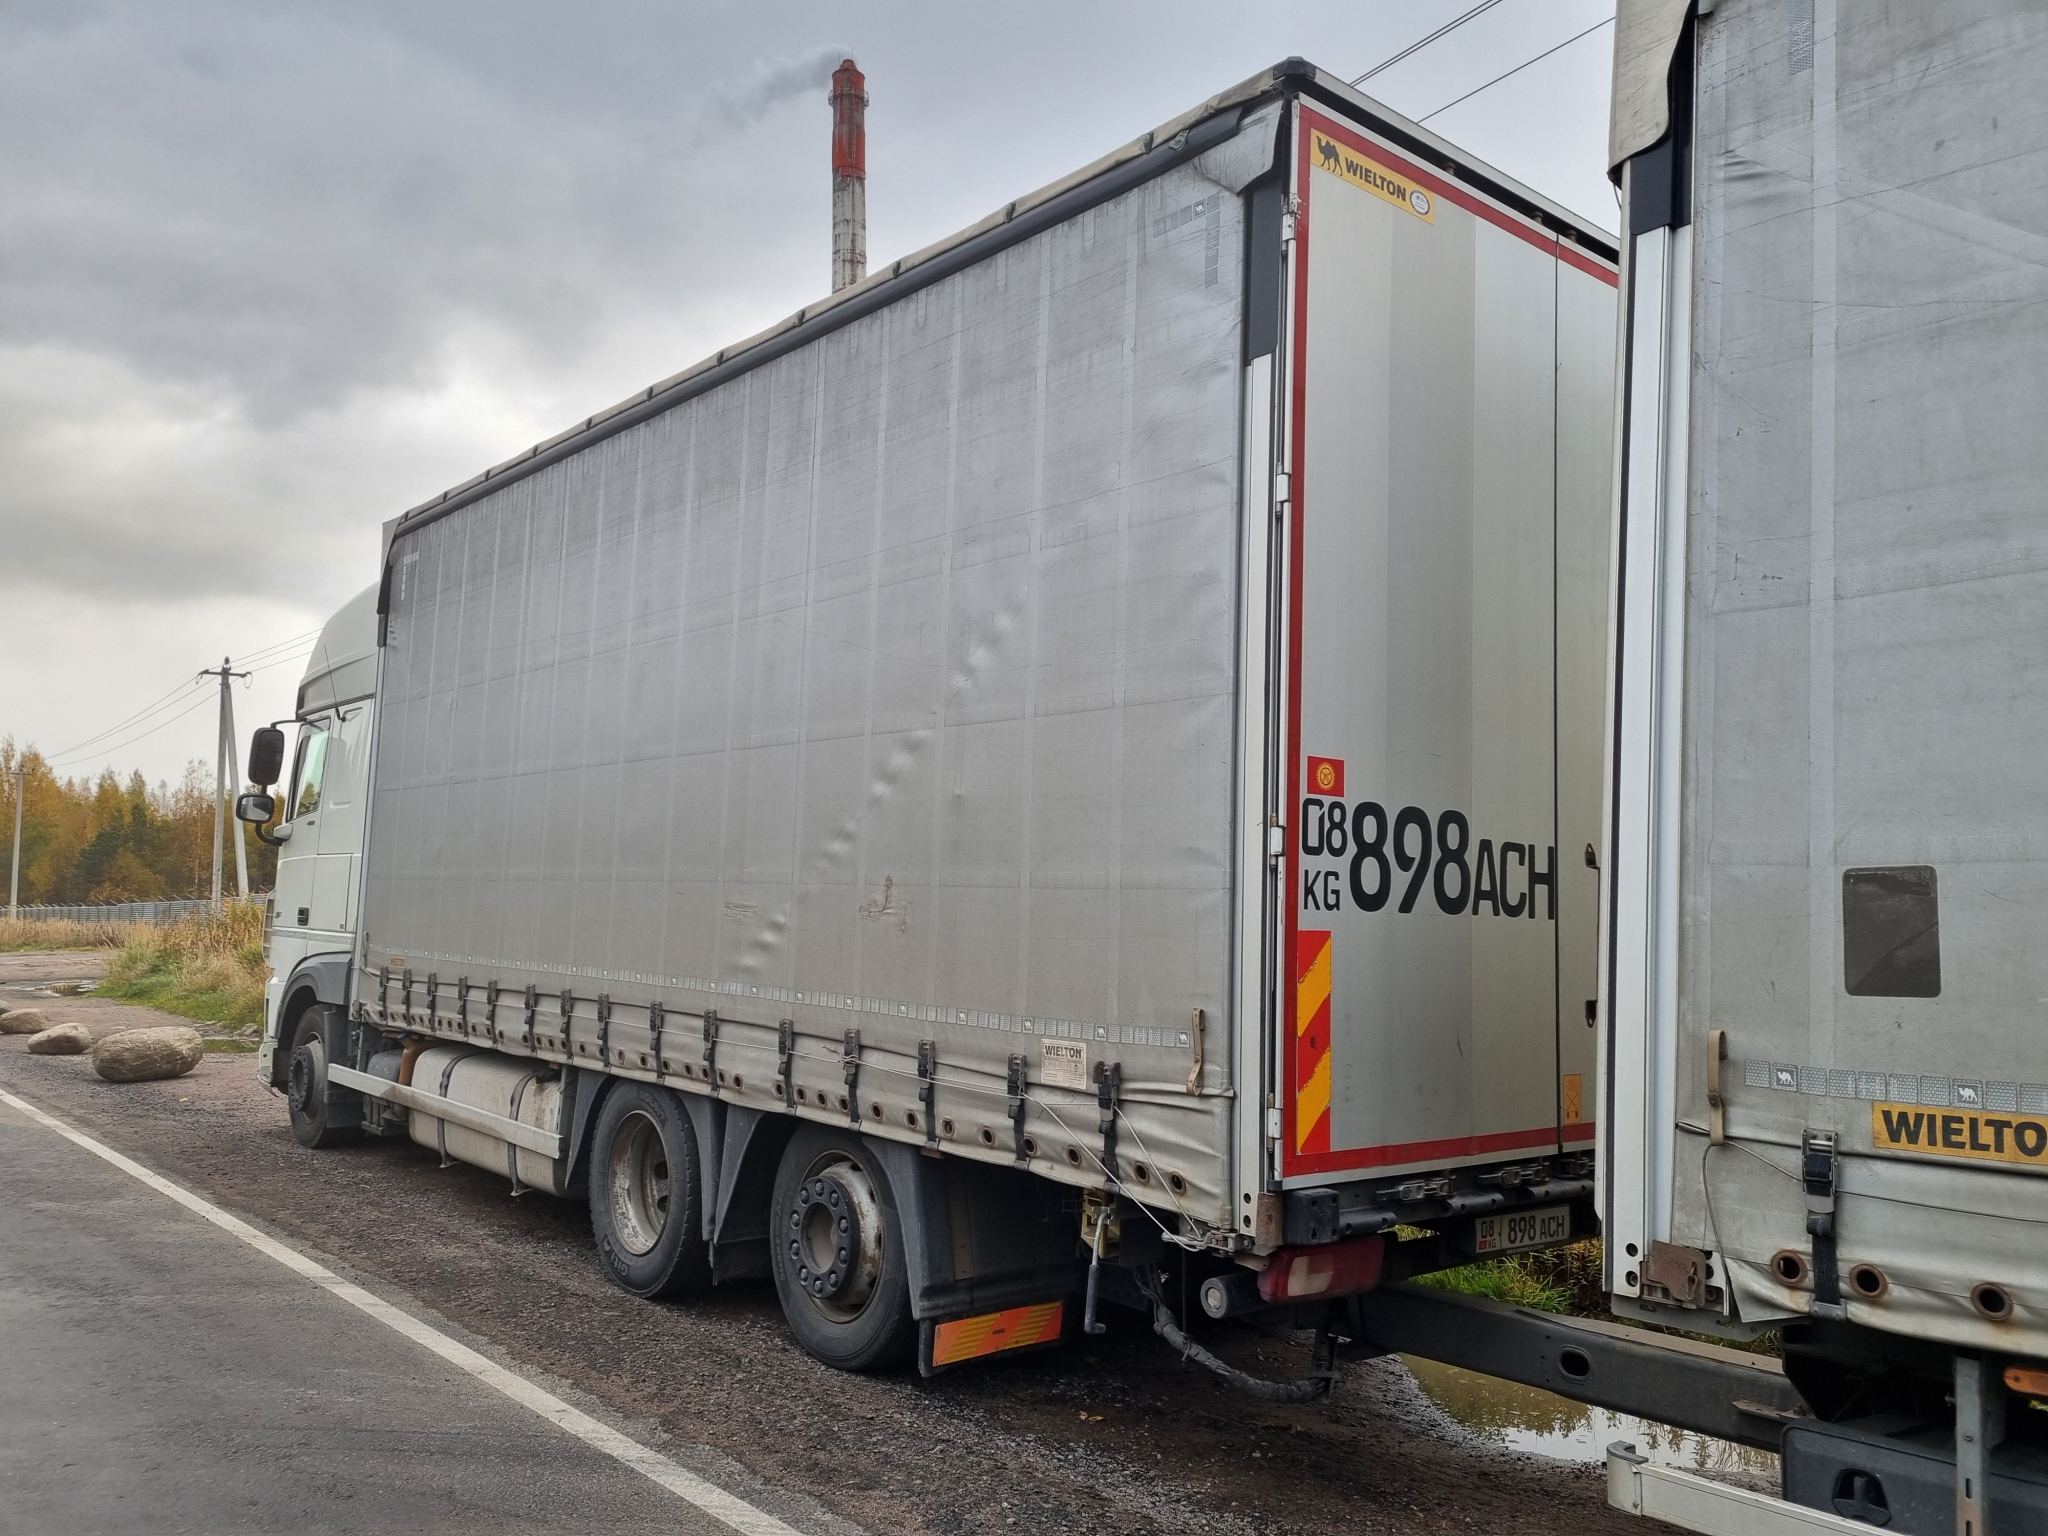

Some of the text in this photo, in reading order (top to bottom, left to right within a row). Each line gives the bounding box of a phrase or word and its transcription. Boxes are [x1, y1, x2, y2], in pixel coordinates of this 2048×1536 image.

[1344, 156, 1407, 203] WIELTON
[1301, 797, 1555, 920] 08 898 ACH
[1303, 869, 1341, 912] KG
[1044, 1045, 1082, 1059] WIELTON
[1881, 1109, 2047, 1157] WIELTO
[1481, 1215, 1565, 1244] 08 898 ACH
[1488, 1238, 1497, 1248] KG
